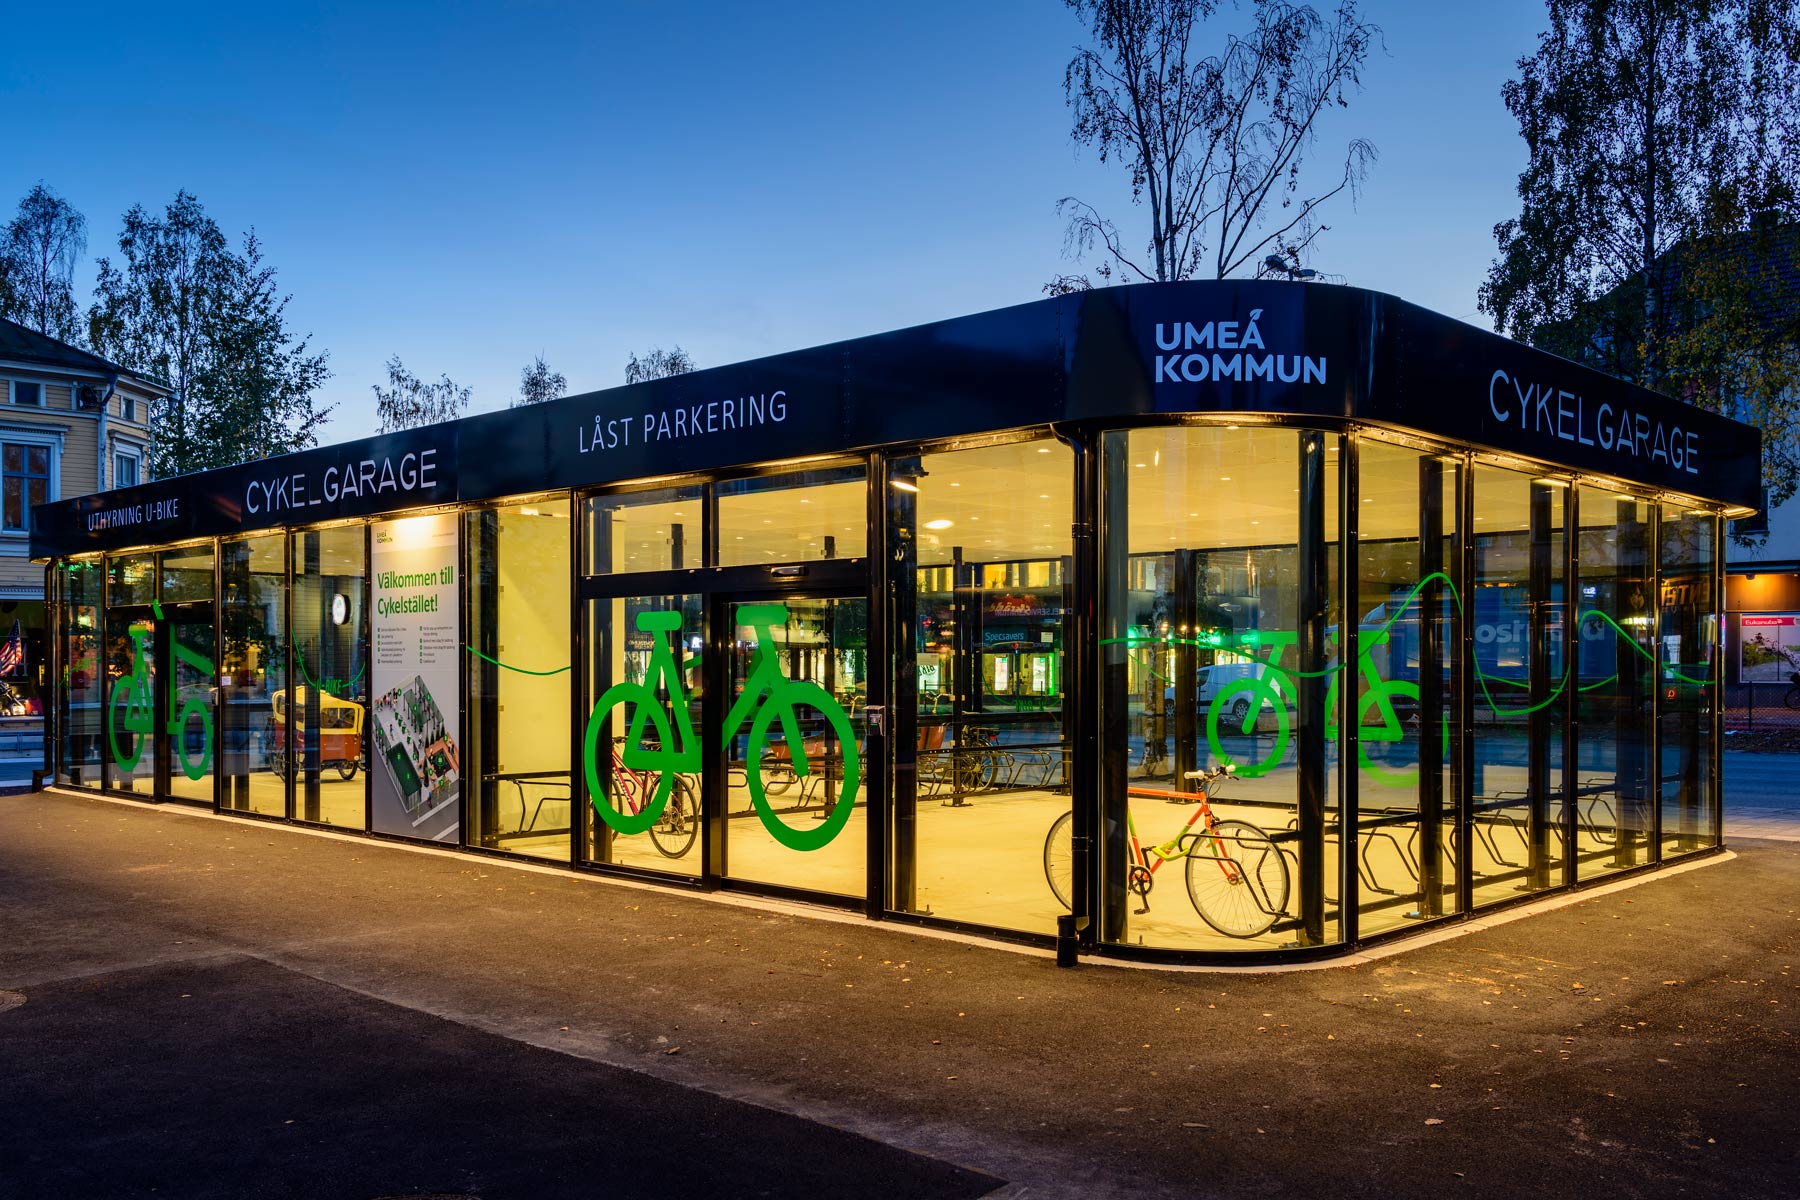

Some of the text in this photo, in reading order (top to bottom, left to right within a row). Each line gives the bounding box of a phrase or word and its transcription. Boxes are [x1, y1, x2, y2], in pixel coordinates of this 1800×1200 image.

[1155, 308, 1266, 351] UMEÅ
[1155, 353, 1327, 385] KOMMUN
[579, 390, 786, 453] LÅST PARKERING
[1489, 369, 1699, 475] CYKELGARAGE
[88, 498, 179, 531] UTHYRNING U-BIKE
[377, 565, 454, 590] Välkommen till
[377, 593, 438, 619] Cykelstället!
[984, 632, 1025, 642] Specsavers
